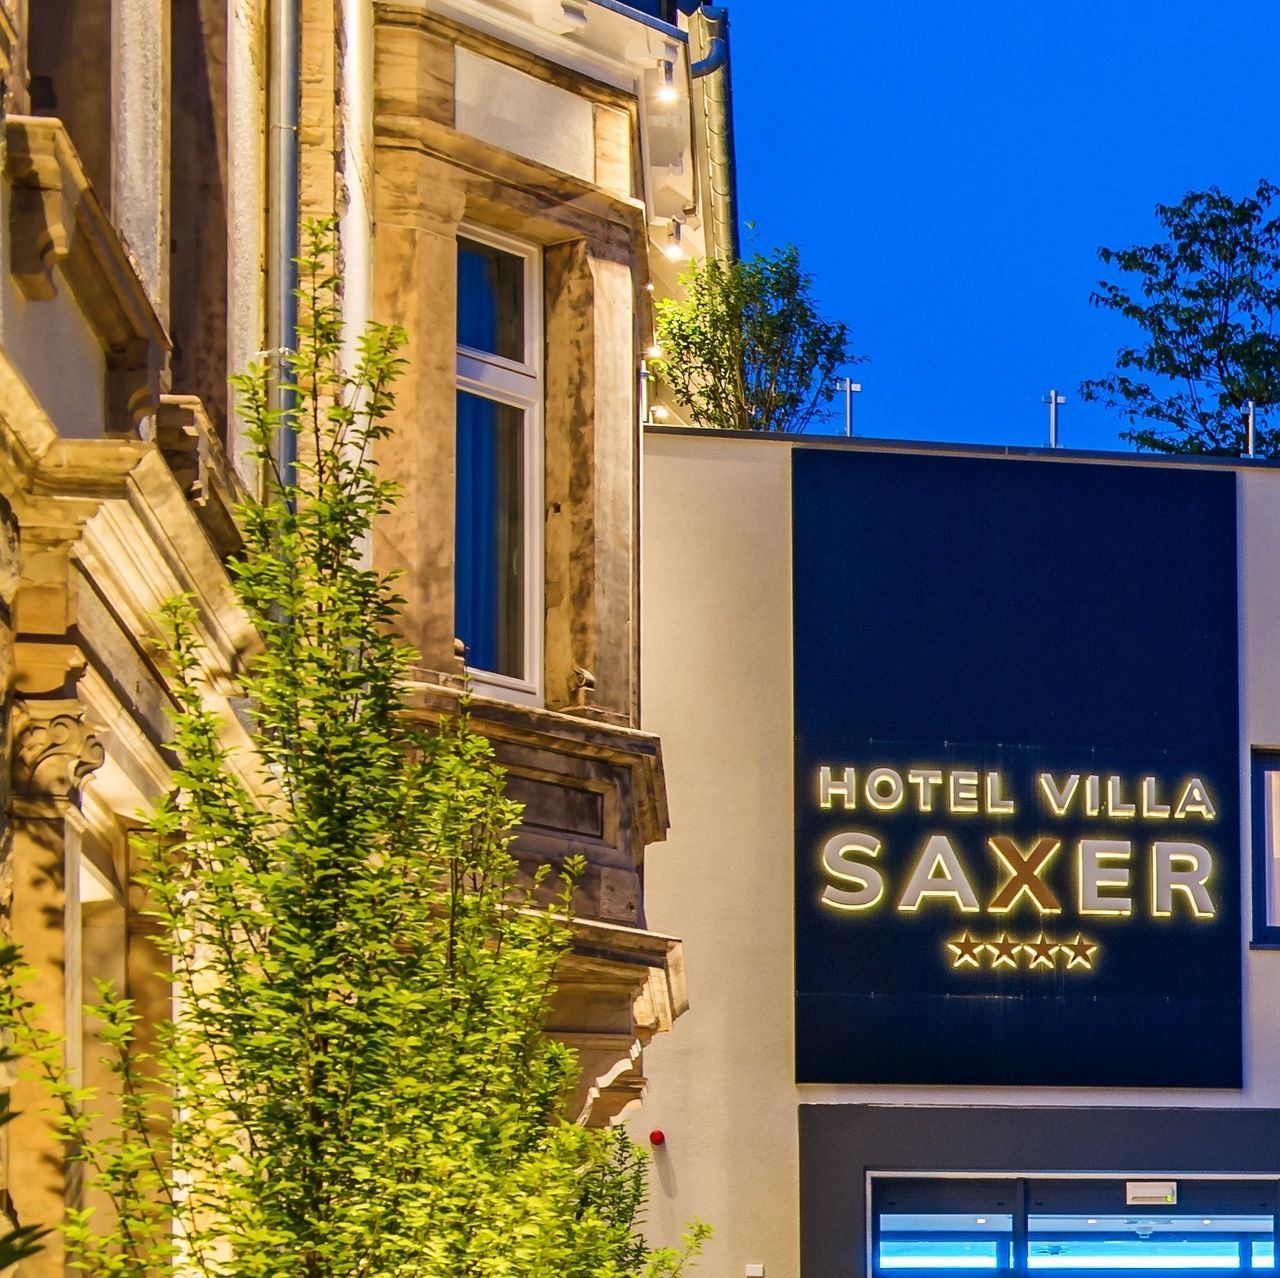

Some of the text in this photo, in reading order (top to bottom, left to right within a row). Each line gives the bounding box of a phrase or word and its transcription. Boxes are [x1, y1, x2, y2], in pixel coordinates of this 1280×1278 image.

[818, 766, 1216, 820] HOTEL VILLA
[821, 831, 1216, 917] SAXER
